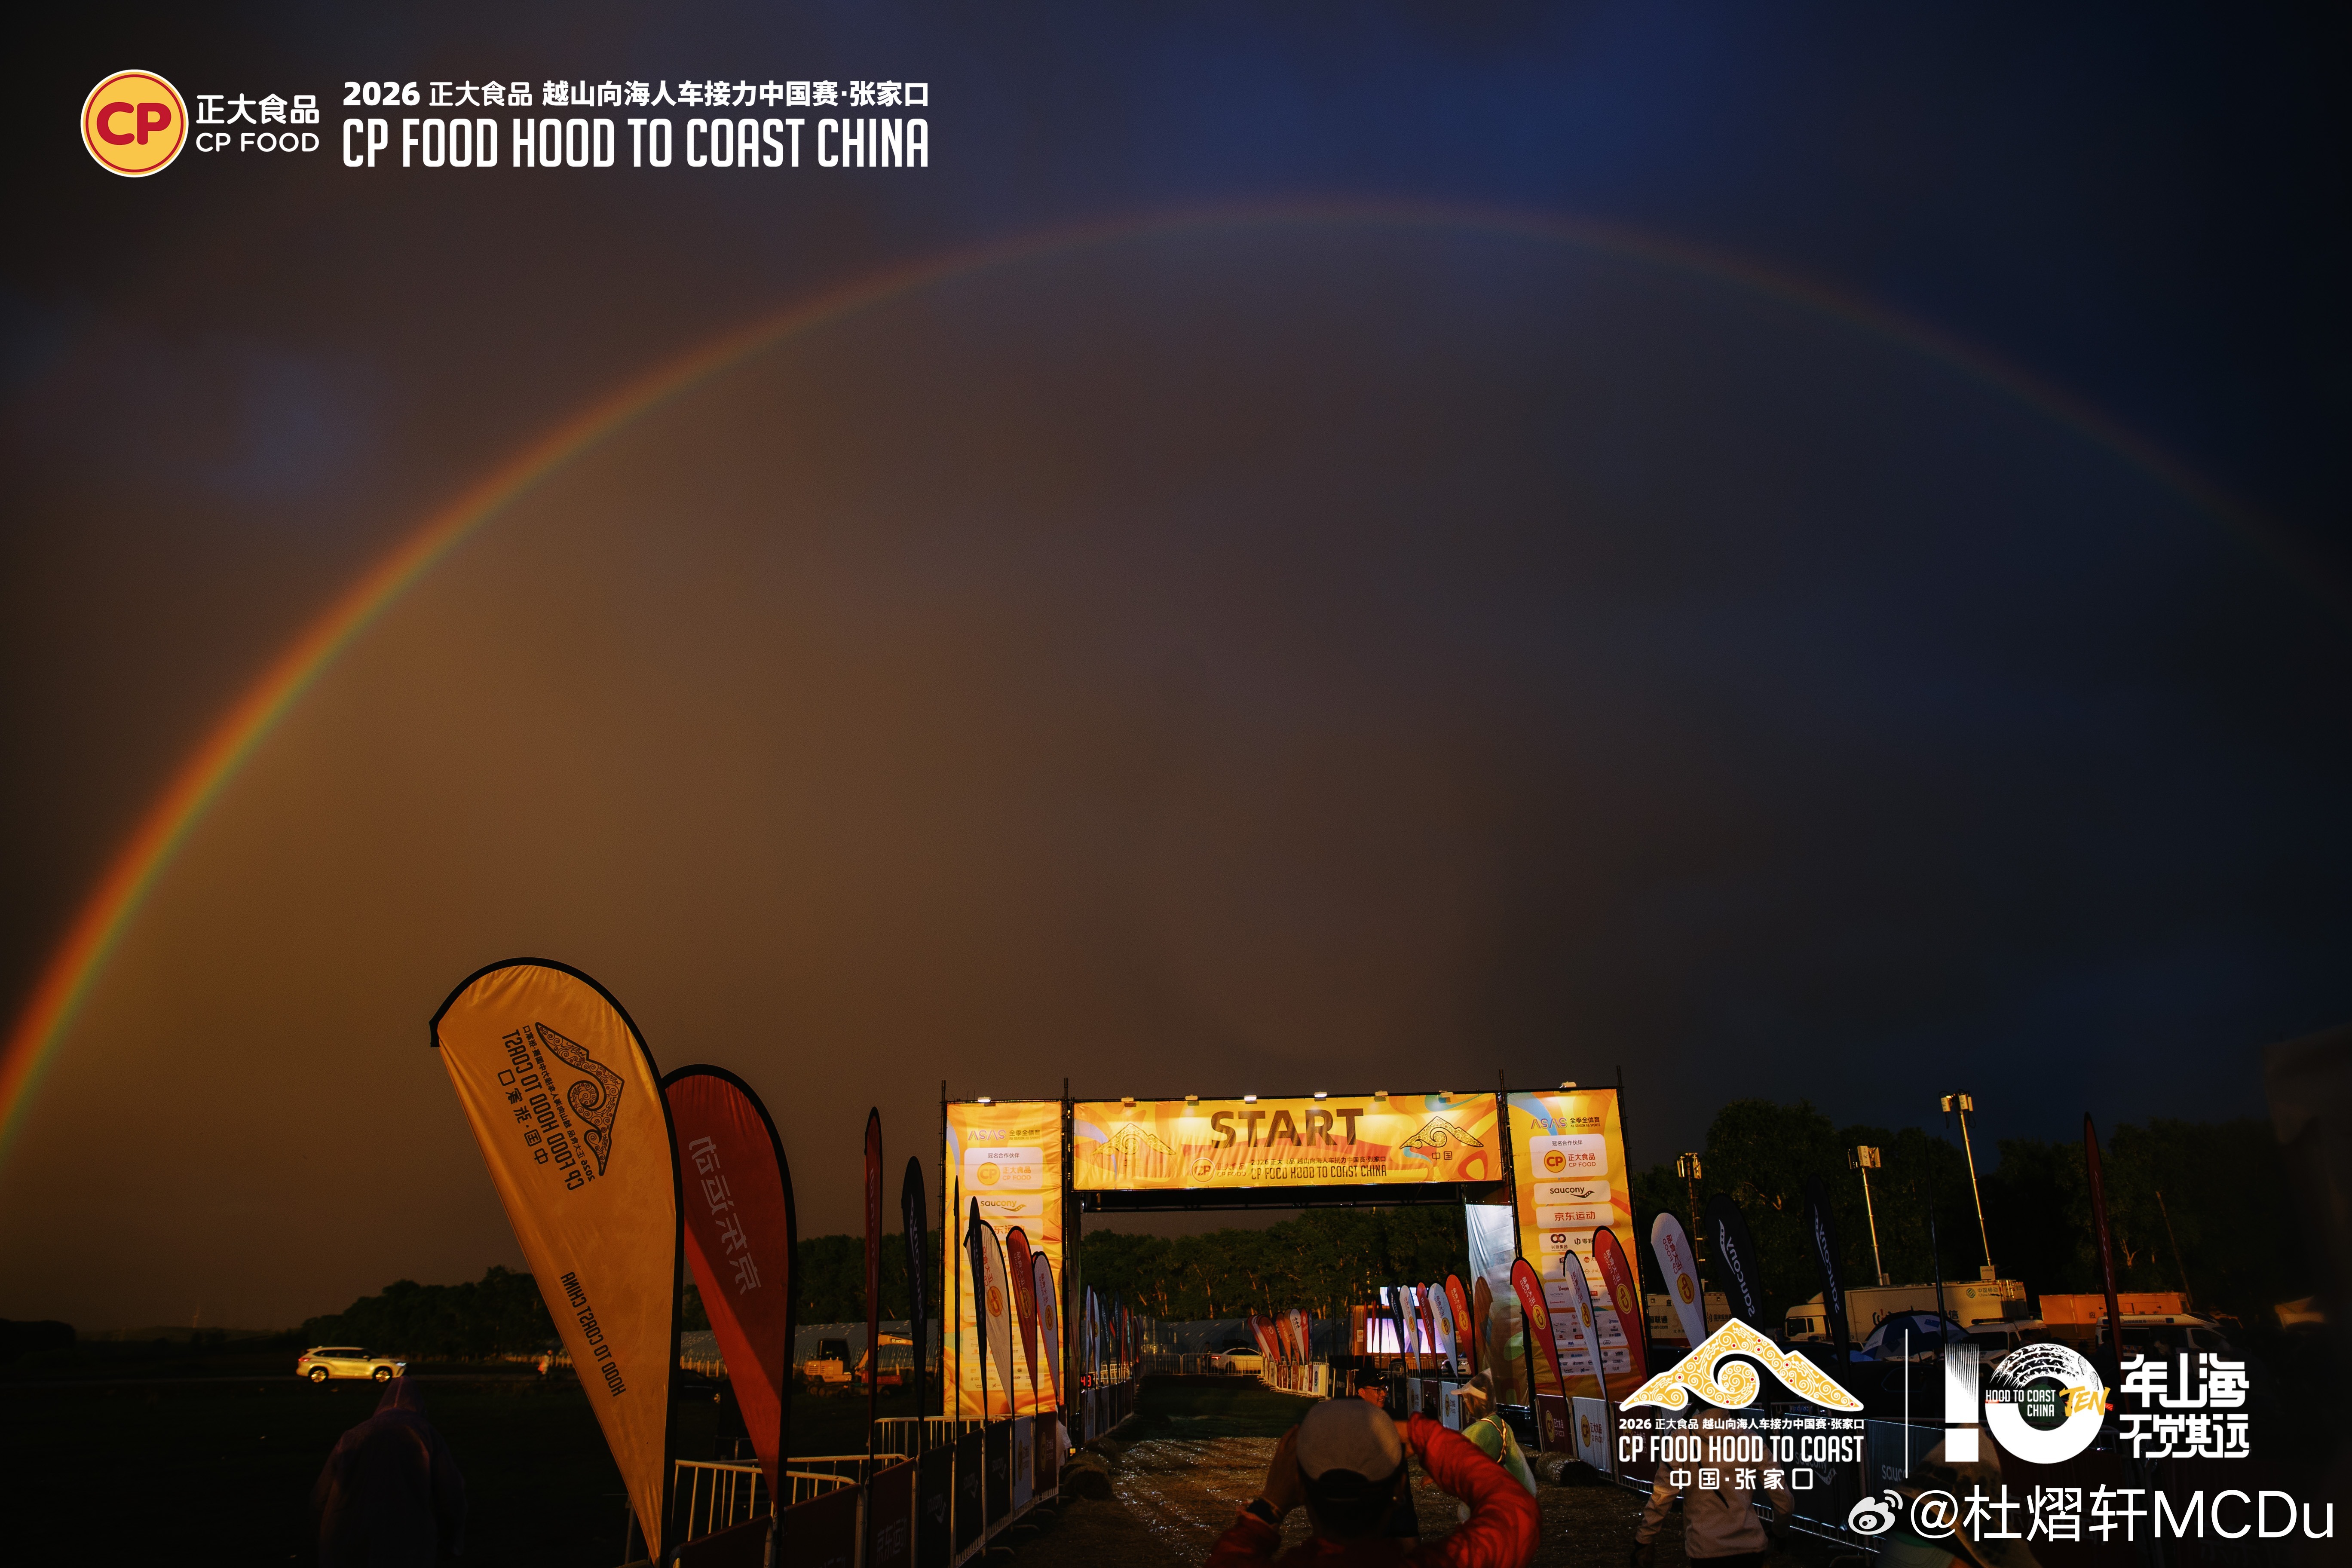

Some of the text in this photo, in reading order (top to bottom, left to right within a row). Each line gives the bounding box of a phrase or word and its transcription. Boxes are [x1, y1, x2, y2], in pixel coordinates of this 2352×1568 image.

[1211, 1108, 1364, 1149] START
[1431, 1151, 1453, 1161] 中国
[1547, 1156, 1563, 1167] CP
[1568, 1153, 1596, 1161] 正大食品
[980, 1168, 997, 1179] CP
[1194, 1165, 1211, 1176] CP
[1290, 1166, 1315, 1179] HOOD
[1317, 1166, 1328, 1178] TO
[1330, 1165, 1360, 1177] COAST
[1361, 1164, 1387, 1176] CHINA
[1554, 1211, 1596, 1222] 京东运动
